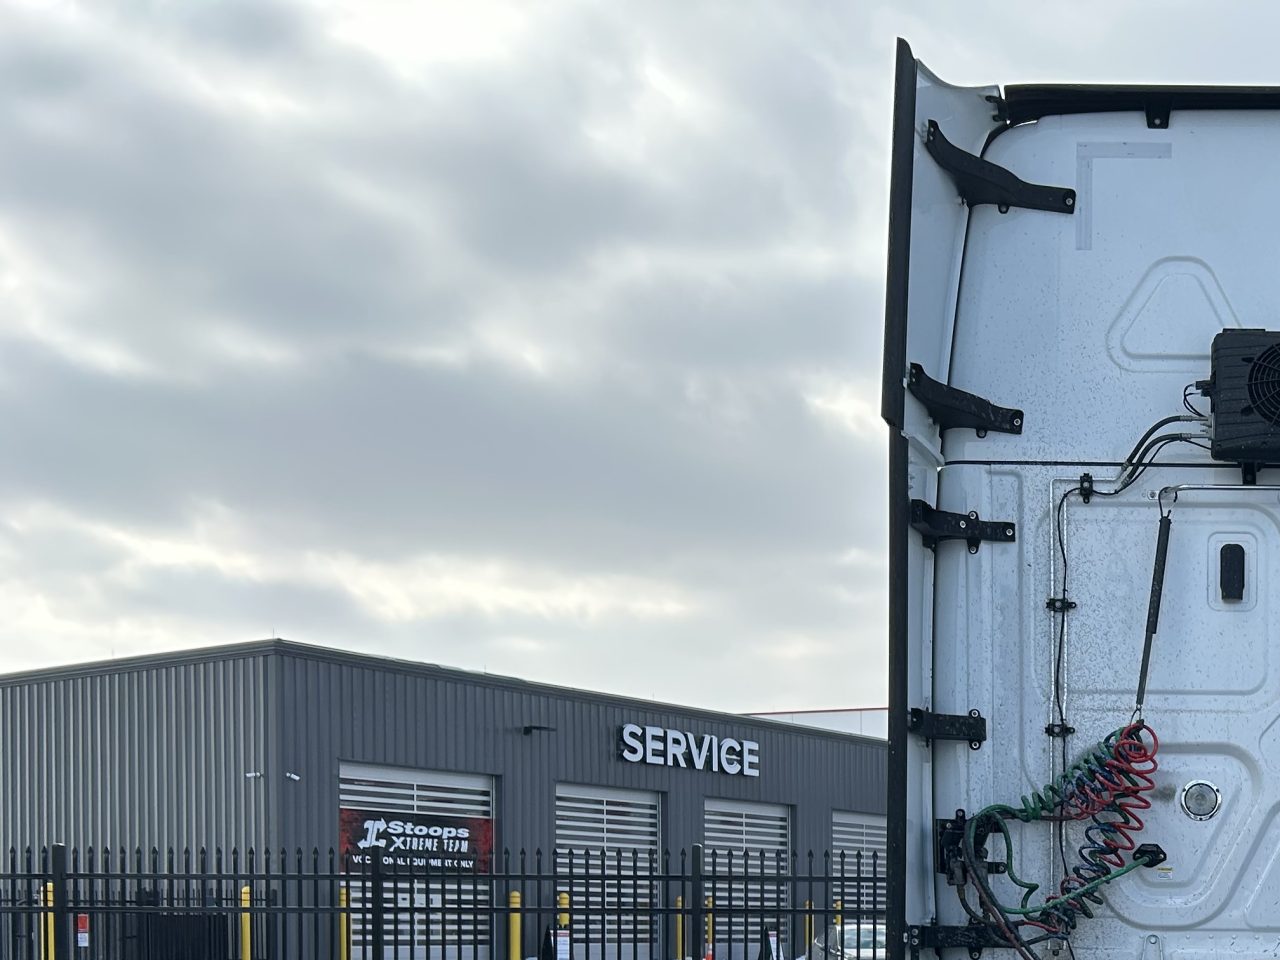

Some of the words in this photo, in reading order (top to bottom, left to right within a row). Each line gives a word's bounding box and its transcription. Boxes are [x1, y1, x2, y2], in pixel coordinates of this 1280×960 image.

[622, 723, 760, 777] SERVICE
[386, 820, 470, 839] Stoops
[388, 835, 439, 852] XTREME
[443, 839, 469, 853] TEAM
[352, 855, 406, 866] VOCONAL
